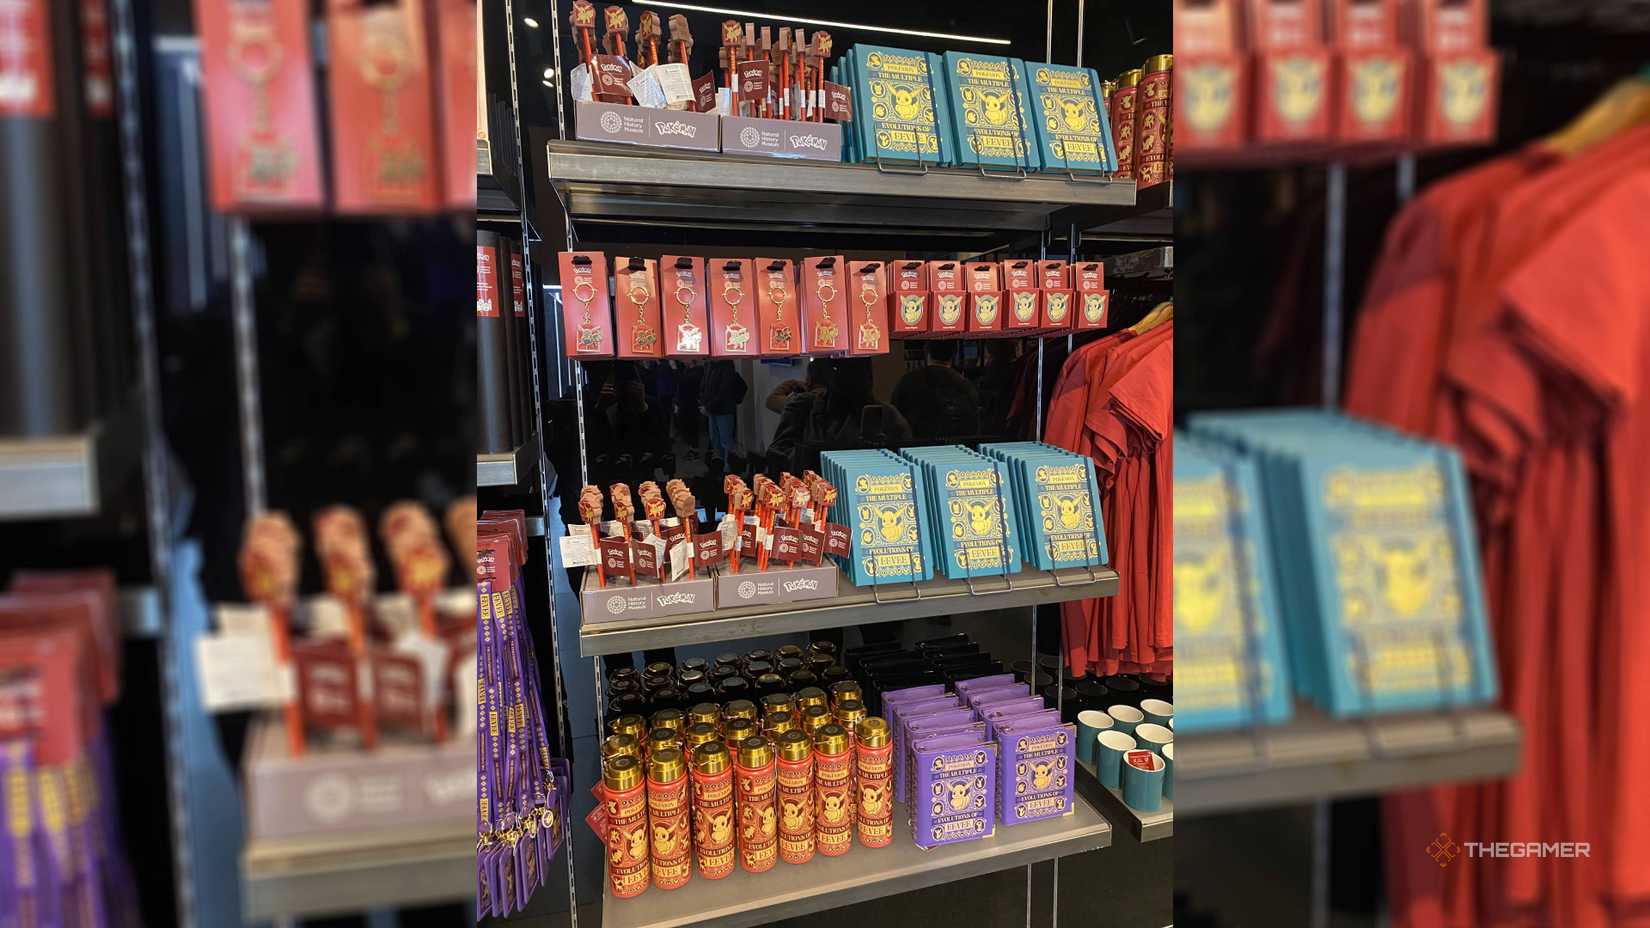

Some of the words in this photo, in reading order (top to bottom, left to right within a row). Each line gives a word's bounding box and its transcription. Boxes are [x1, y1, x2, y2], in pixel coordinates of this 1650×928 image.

[1033, 750, 1058, 758] MULTIPLE
[950, 768, 976, 776] MULTIPLE
[1021, 793, 1052, 801] EVOLUTIONS
[937, 814, 971, 823] EVOLUTIONS
[947, 821, 972, 831] EEVEE
